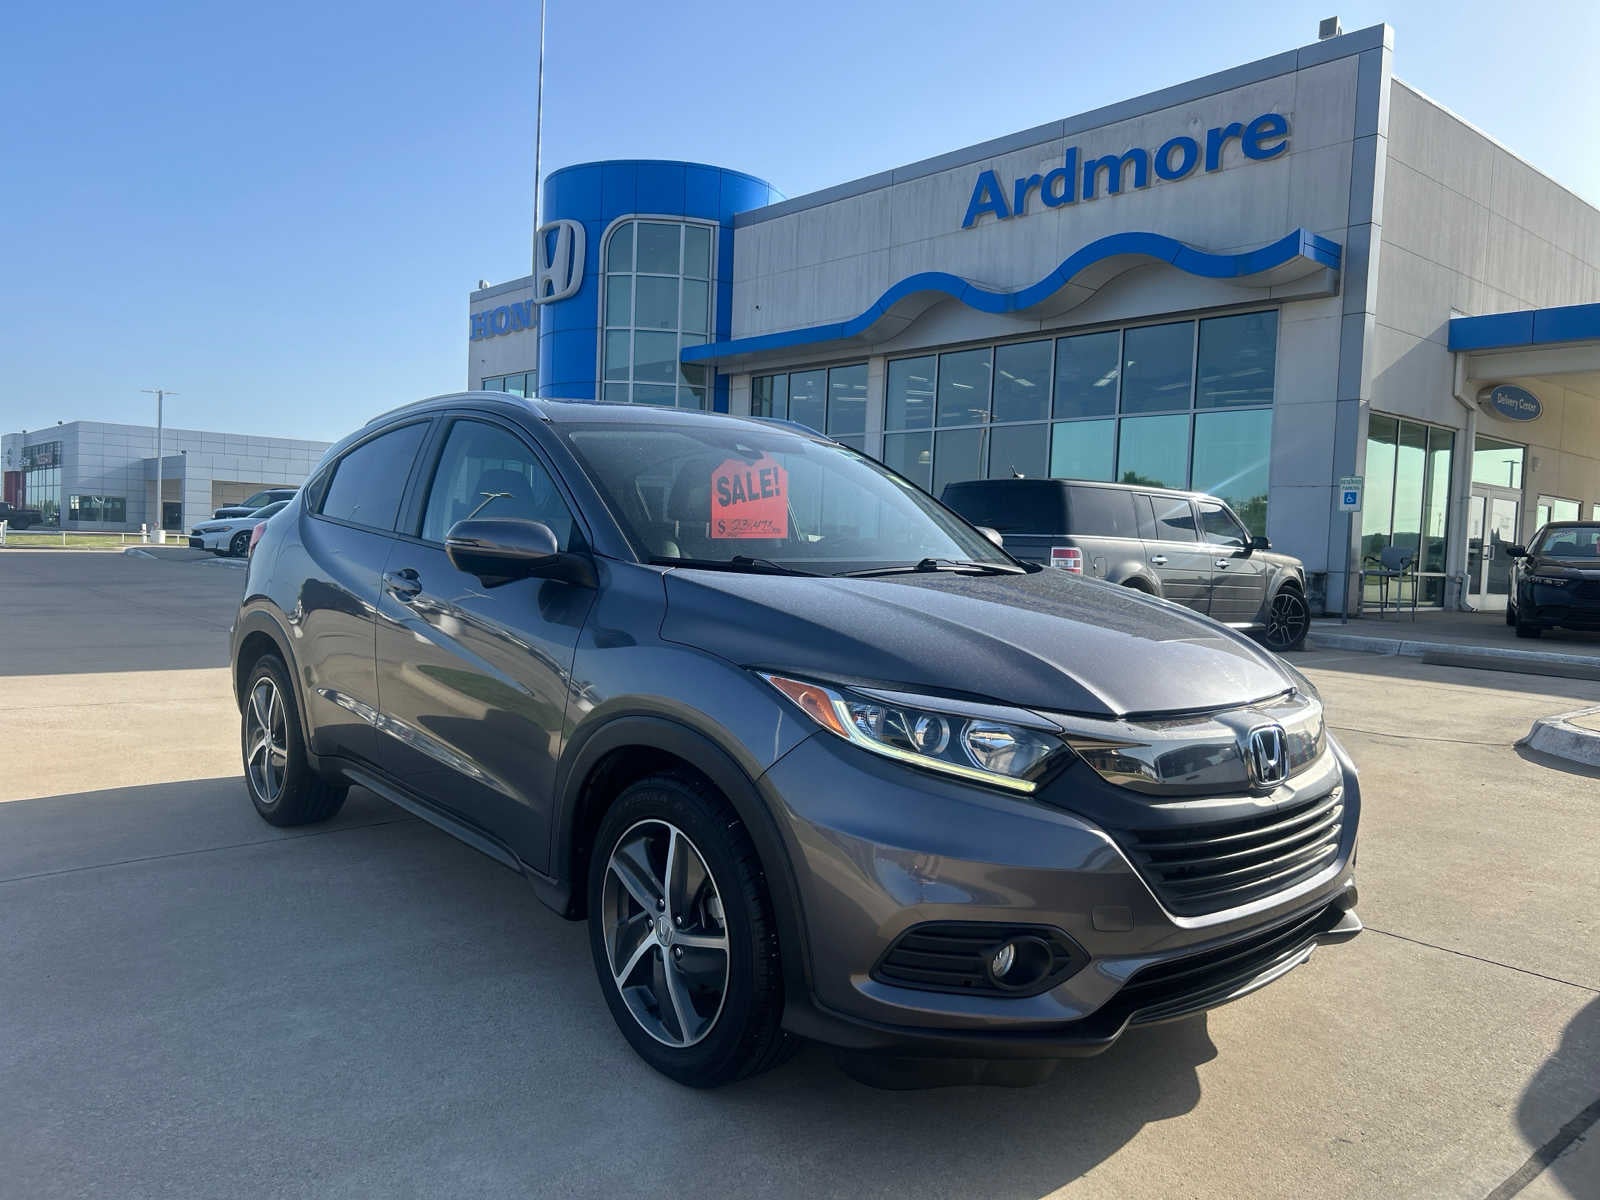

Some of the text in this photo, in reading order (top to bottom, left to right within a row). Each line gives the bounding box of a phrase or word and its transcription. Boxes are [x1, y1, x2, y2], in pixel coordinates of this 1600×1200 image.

[961, 112, 1291, 230] Ardmore
[469, 298, 537, 342] HON
[1496, 391, 1537, 412] Delivery Center
[716, 466, 781, 508] SALE!
